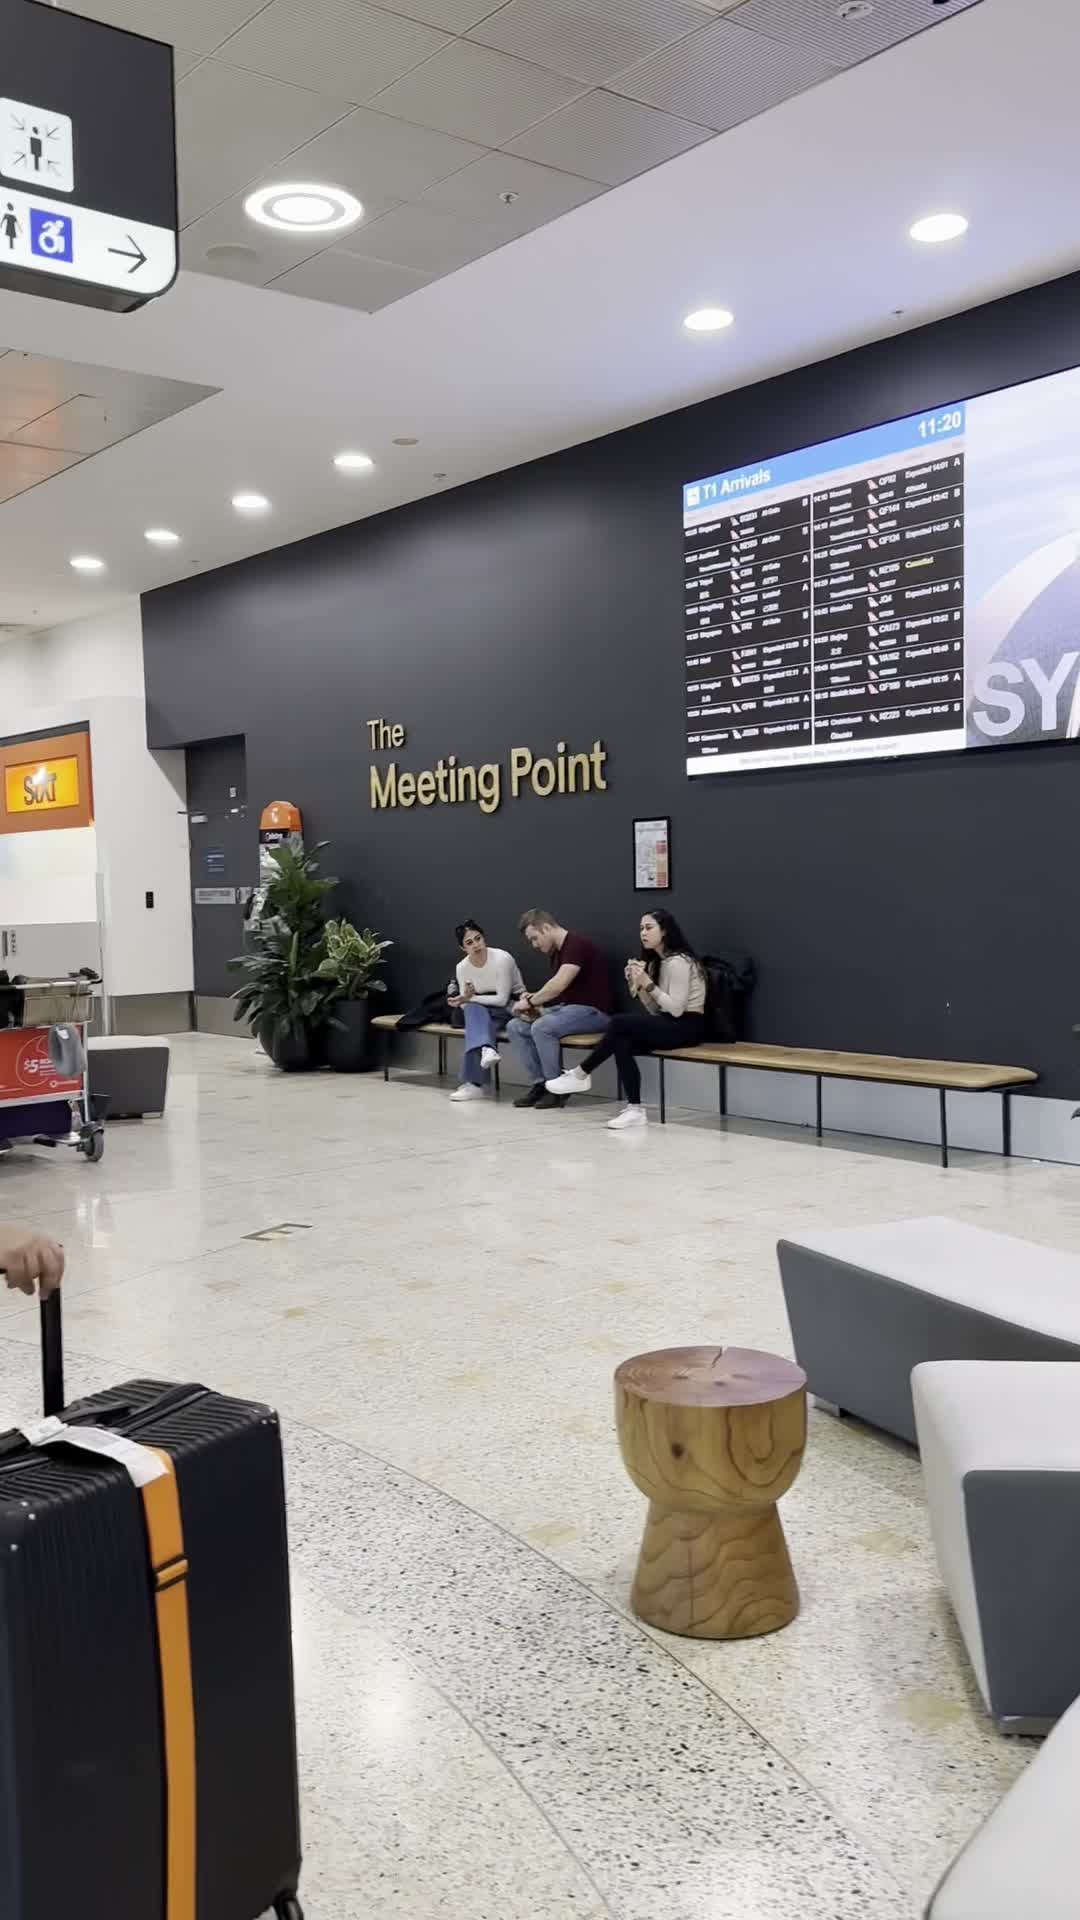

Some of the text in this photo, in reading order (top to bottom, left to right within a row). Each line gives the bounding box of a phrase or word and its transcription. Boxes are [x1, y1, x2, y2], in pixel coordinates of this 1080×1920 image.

[918, 411, 961, 438] 11:20
[702, 468, 771, 499] T1 Arrivals
[366, 718, 405, 750] The
[369, 740, 608, 814] Meeting Point
